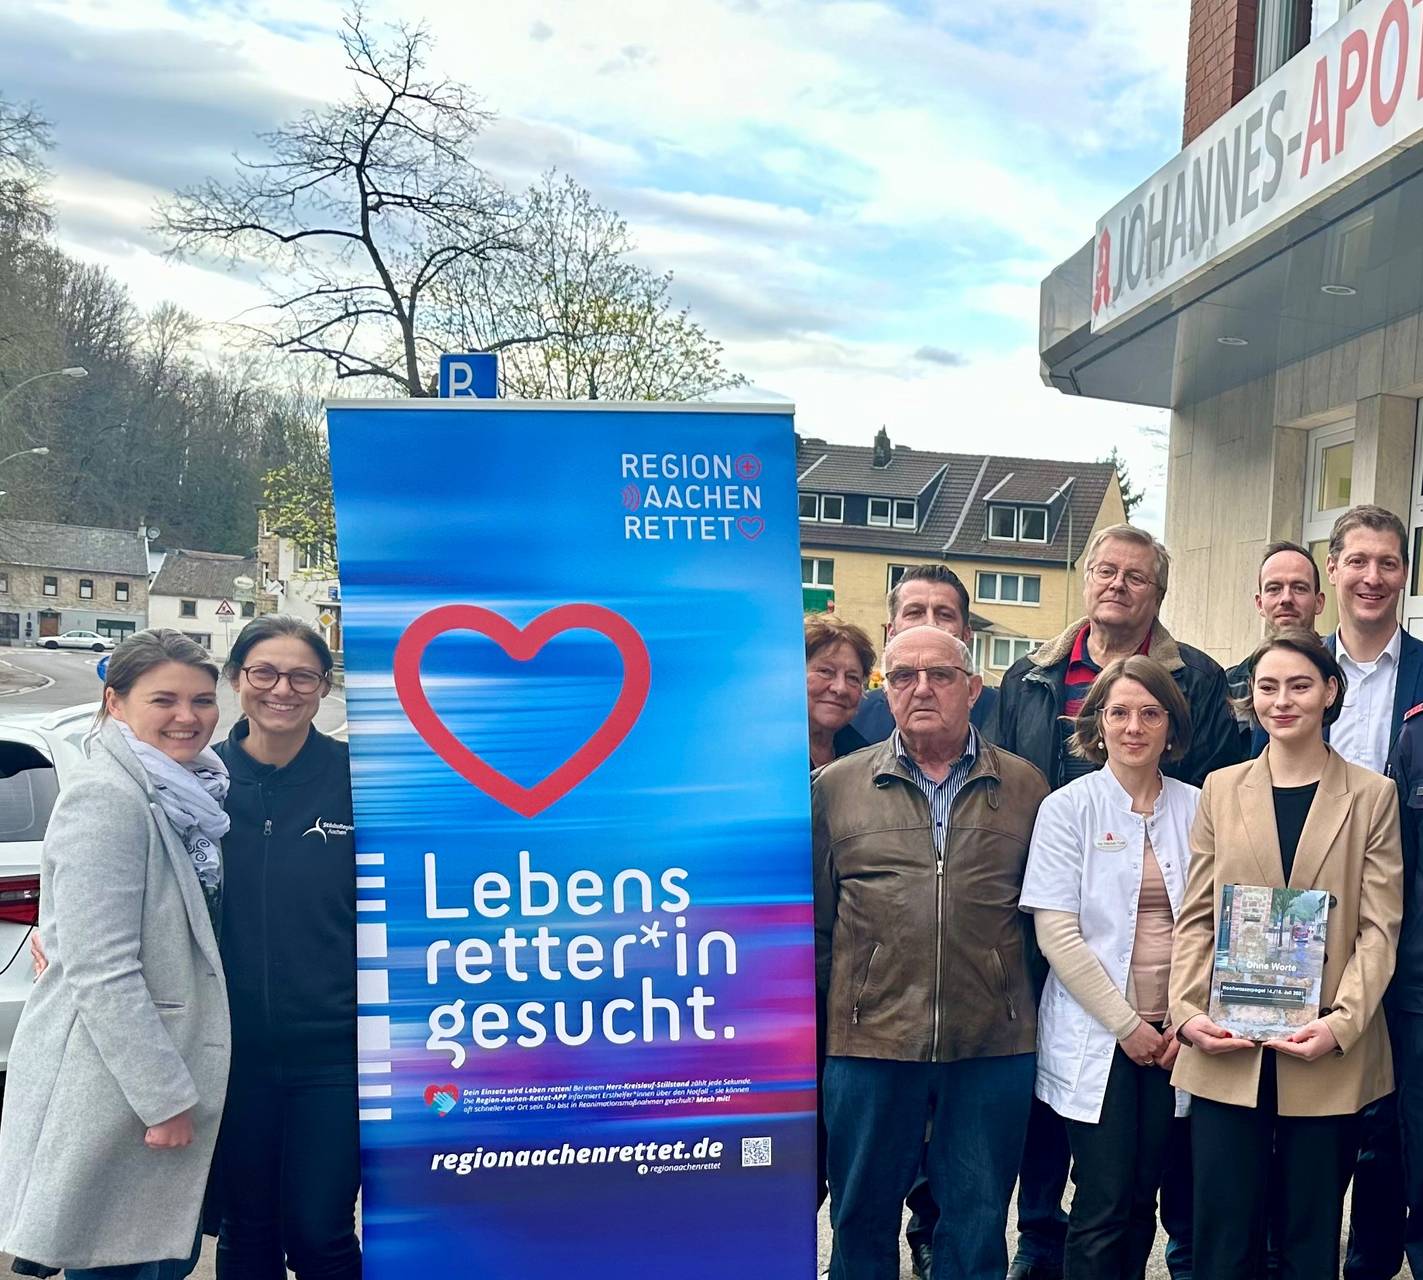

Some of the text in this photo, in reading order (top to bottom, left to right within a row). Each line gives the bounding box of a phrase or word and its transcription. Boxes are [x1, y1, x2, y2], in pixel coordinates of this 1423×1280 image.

[621, 453, 732, 479] REGION
[643, 484, 761, 509] AACHEN
[624, 515, 734, 540] RETTET
[424, 850, 690, 919] Lebens
[1246, 961, 1297, 972] Ohne Worte
[425, 976, 736, 1069] gesucht.
[476, 1094, 567, 1105] Region-Aachen-Rettet-APP
[568, 1092, 601, 1101] informiert
[656, 1089, 671, 1097] über
[687, 1088, 708, 1096] Notfall
[725, 1086, 750, 1094] können
[606, 1081, 690, 1090] Herz-Kreislauf-Stillstand
[723, 1078, 752, 1086] Sekunde.
[463, 1106, 473, 1114] oft
[474, 1105, 503, 1113] schneller
[665, 1096, 694, 1106] geschult?
[430, 1137, 724, 1175] regionaachenrettet.de
[650, 1162, 721, 1175] regionaachenrettet
